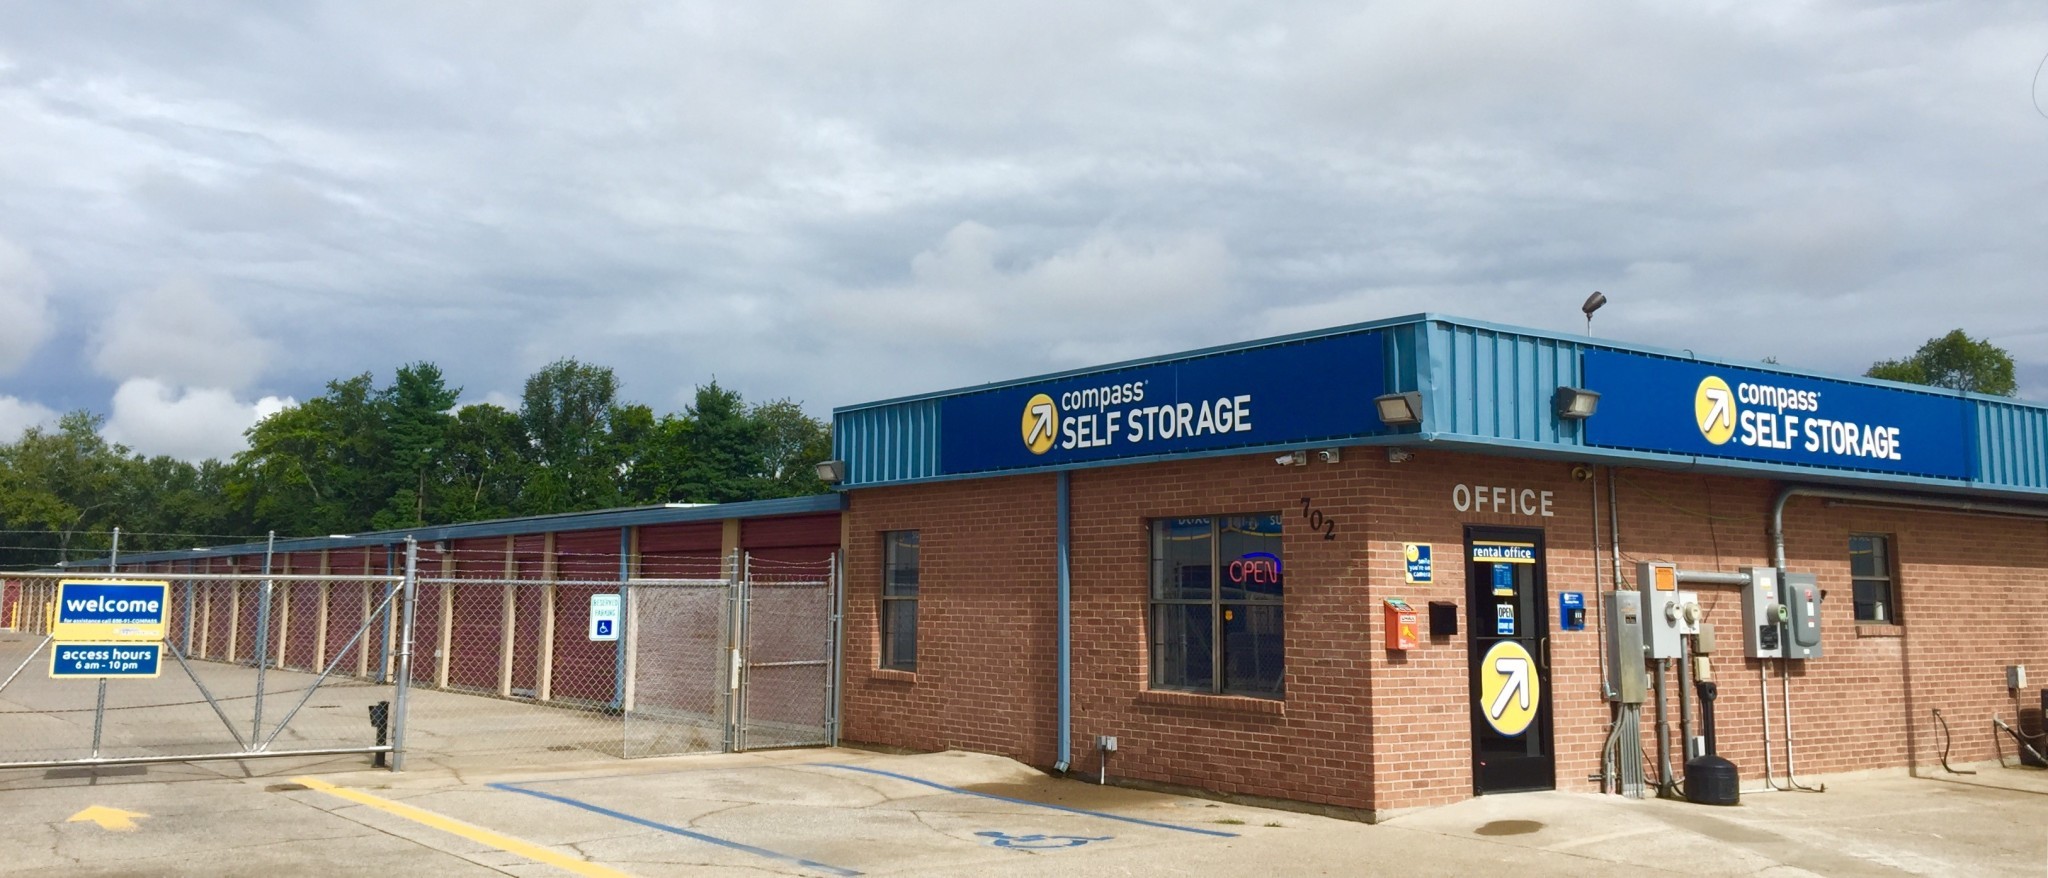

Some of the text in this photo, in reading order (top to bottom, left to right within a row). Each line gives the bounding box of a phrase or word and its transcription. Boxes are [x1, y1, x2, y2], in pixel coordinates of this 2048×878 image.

[1061, 380, 1144, 413] compass
[1738, 382, 1818, 415] compass
[1061, 394, 1252, 450] SELF STORAGE
[1740, 409, 1902, 460] SELF STORAGE
[1452, 483, 1554, 517] OFFICE
[1301, 497, 1336, 541] 702
[1473, 546, 1532, 559] rental office
[1229, 560, 1278, 584] OPEN
[66, 595, 159, 613] welcome
[1498, 607, 1513, 618] OPEN
[62, 648, 151, 660] access hours
[75, 661, 82, 669] 6
[109, 661, 121, 669] 10
[122, 662, 138, 671] pm
